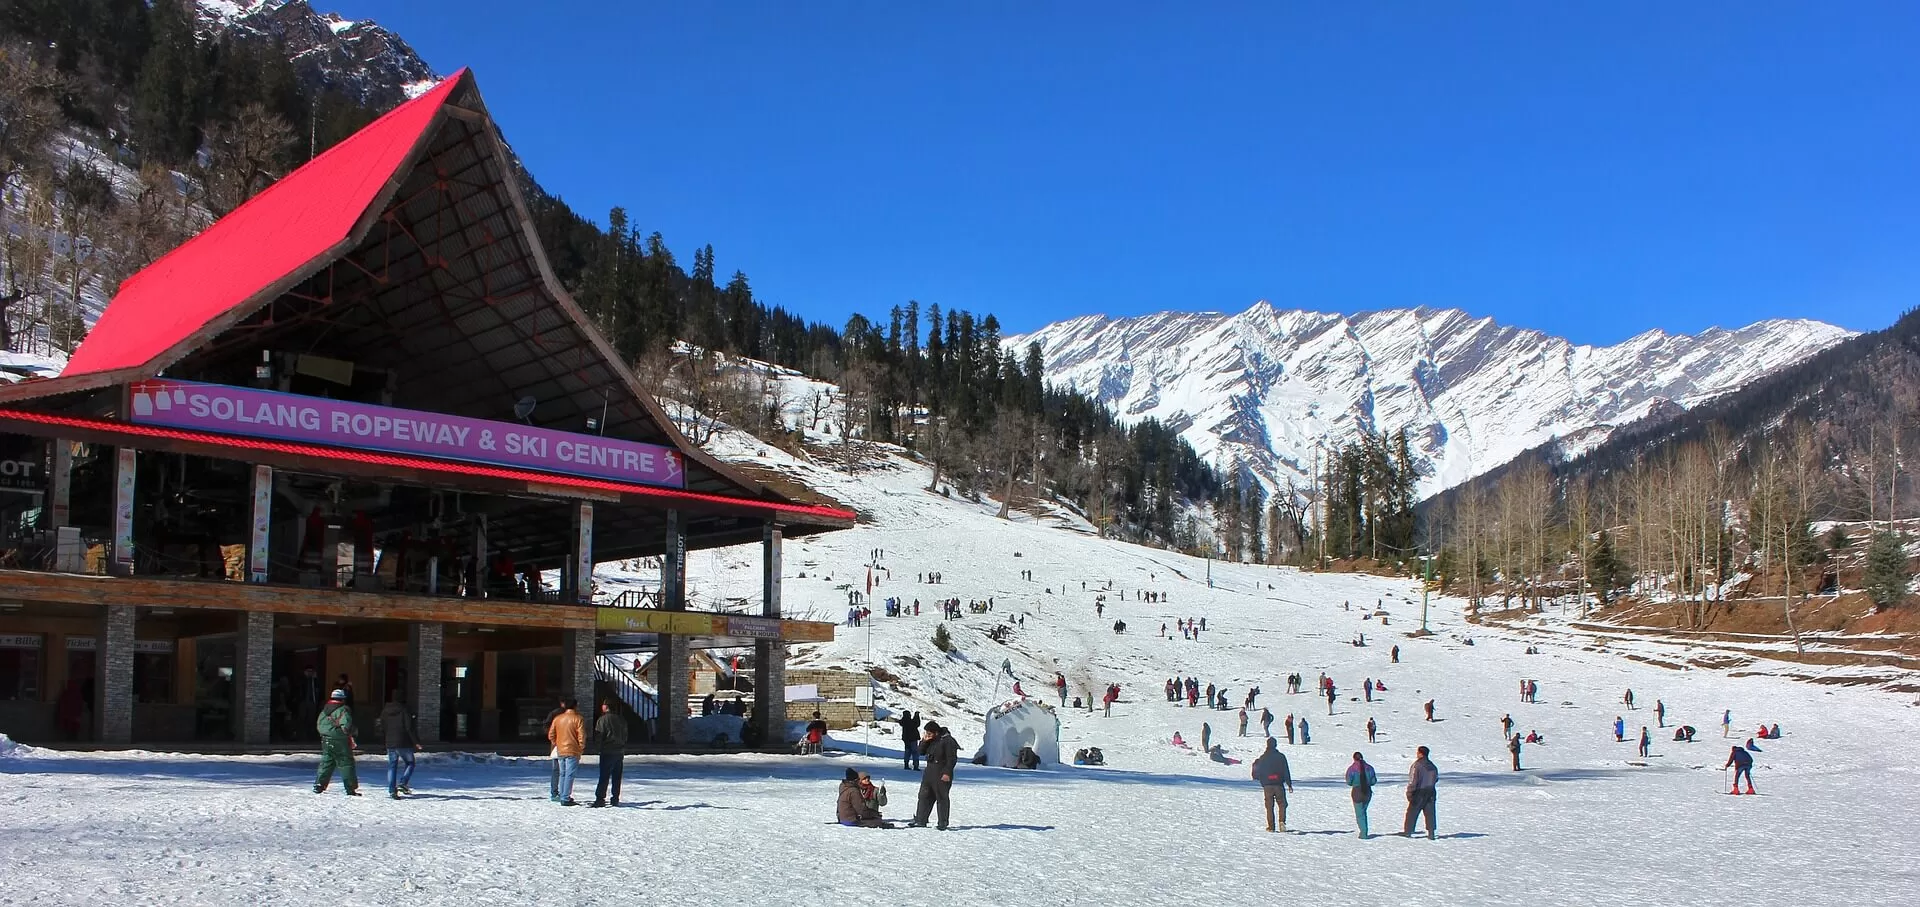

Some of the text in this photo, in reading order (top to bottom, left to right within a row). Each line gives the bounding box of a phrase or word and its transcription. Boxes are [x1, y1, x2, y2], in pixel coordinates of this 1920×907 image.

[188, 394, 655, 473] SOLANG ROPEWAY & SKI CENTRE
[676, 533, 684, 570] TISSOT
